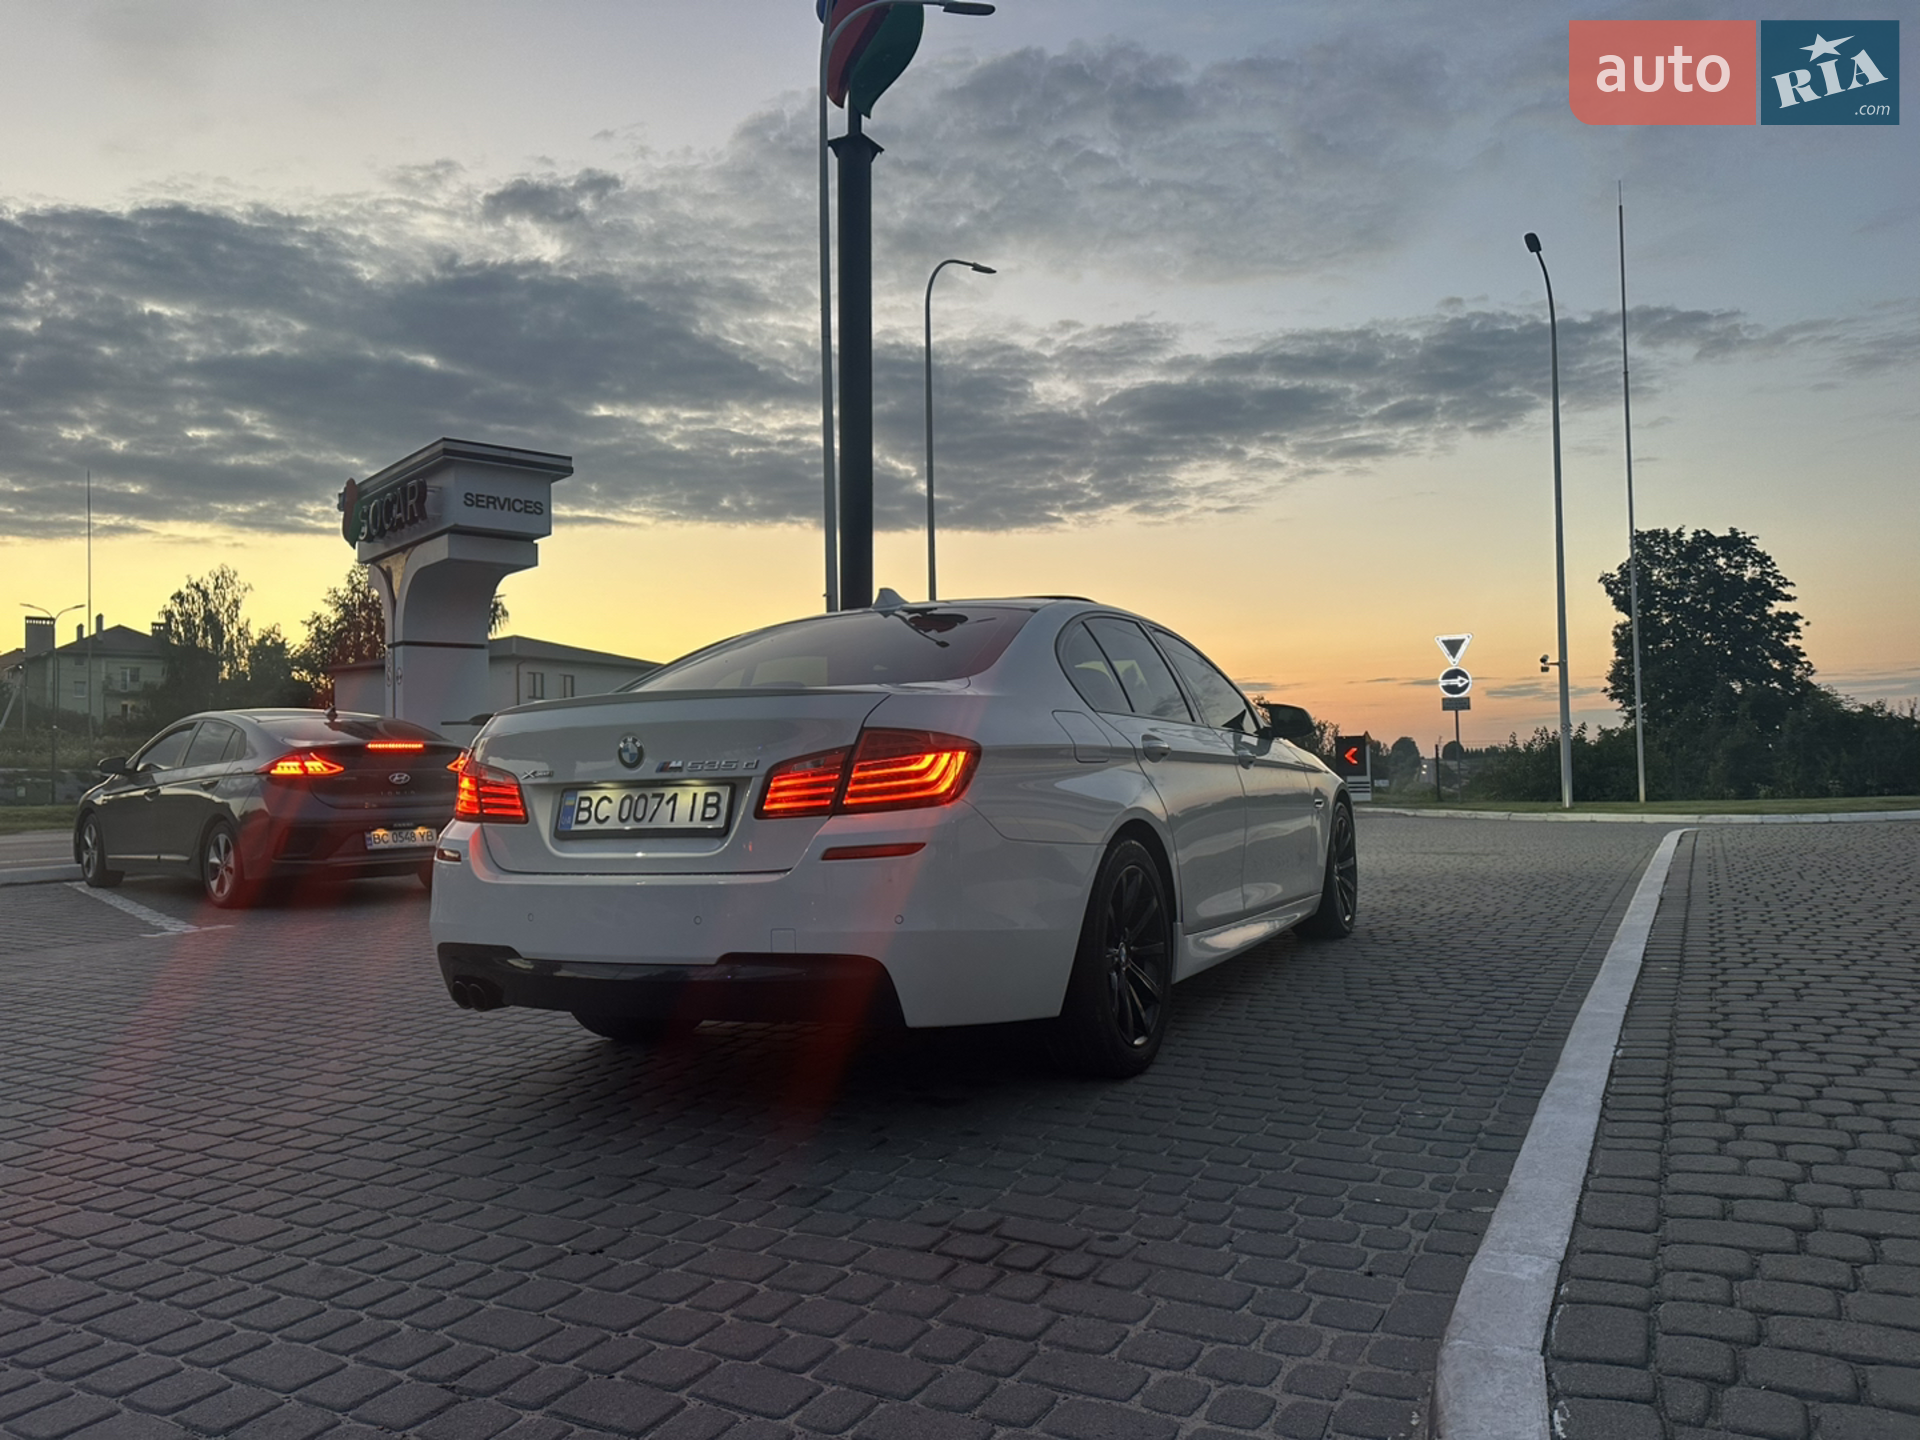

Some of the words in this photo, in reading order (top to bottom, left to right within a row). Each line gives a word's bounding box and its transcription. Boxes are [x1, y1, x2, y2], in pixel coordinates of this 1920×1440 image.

[358, 478, 428, 543] SOCAR
[463, 491, 545, 516] SERVICES
[574, 795, 613, 825] BC
[617, 792, 679, 823] 0071
[688, 791, 721, 823] IB
[372, 832, 389, 845] BC
[391, 831, 417, 844] 0548
[418, 830, 435, 842] YB
